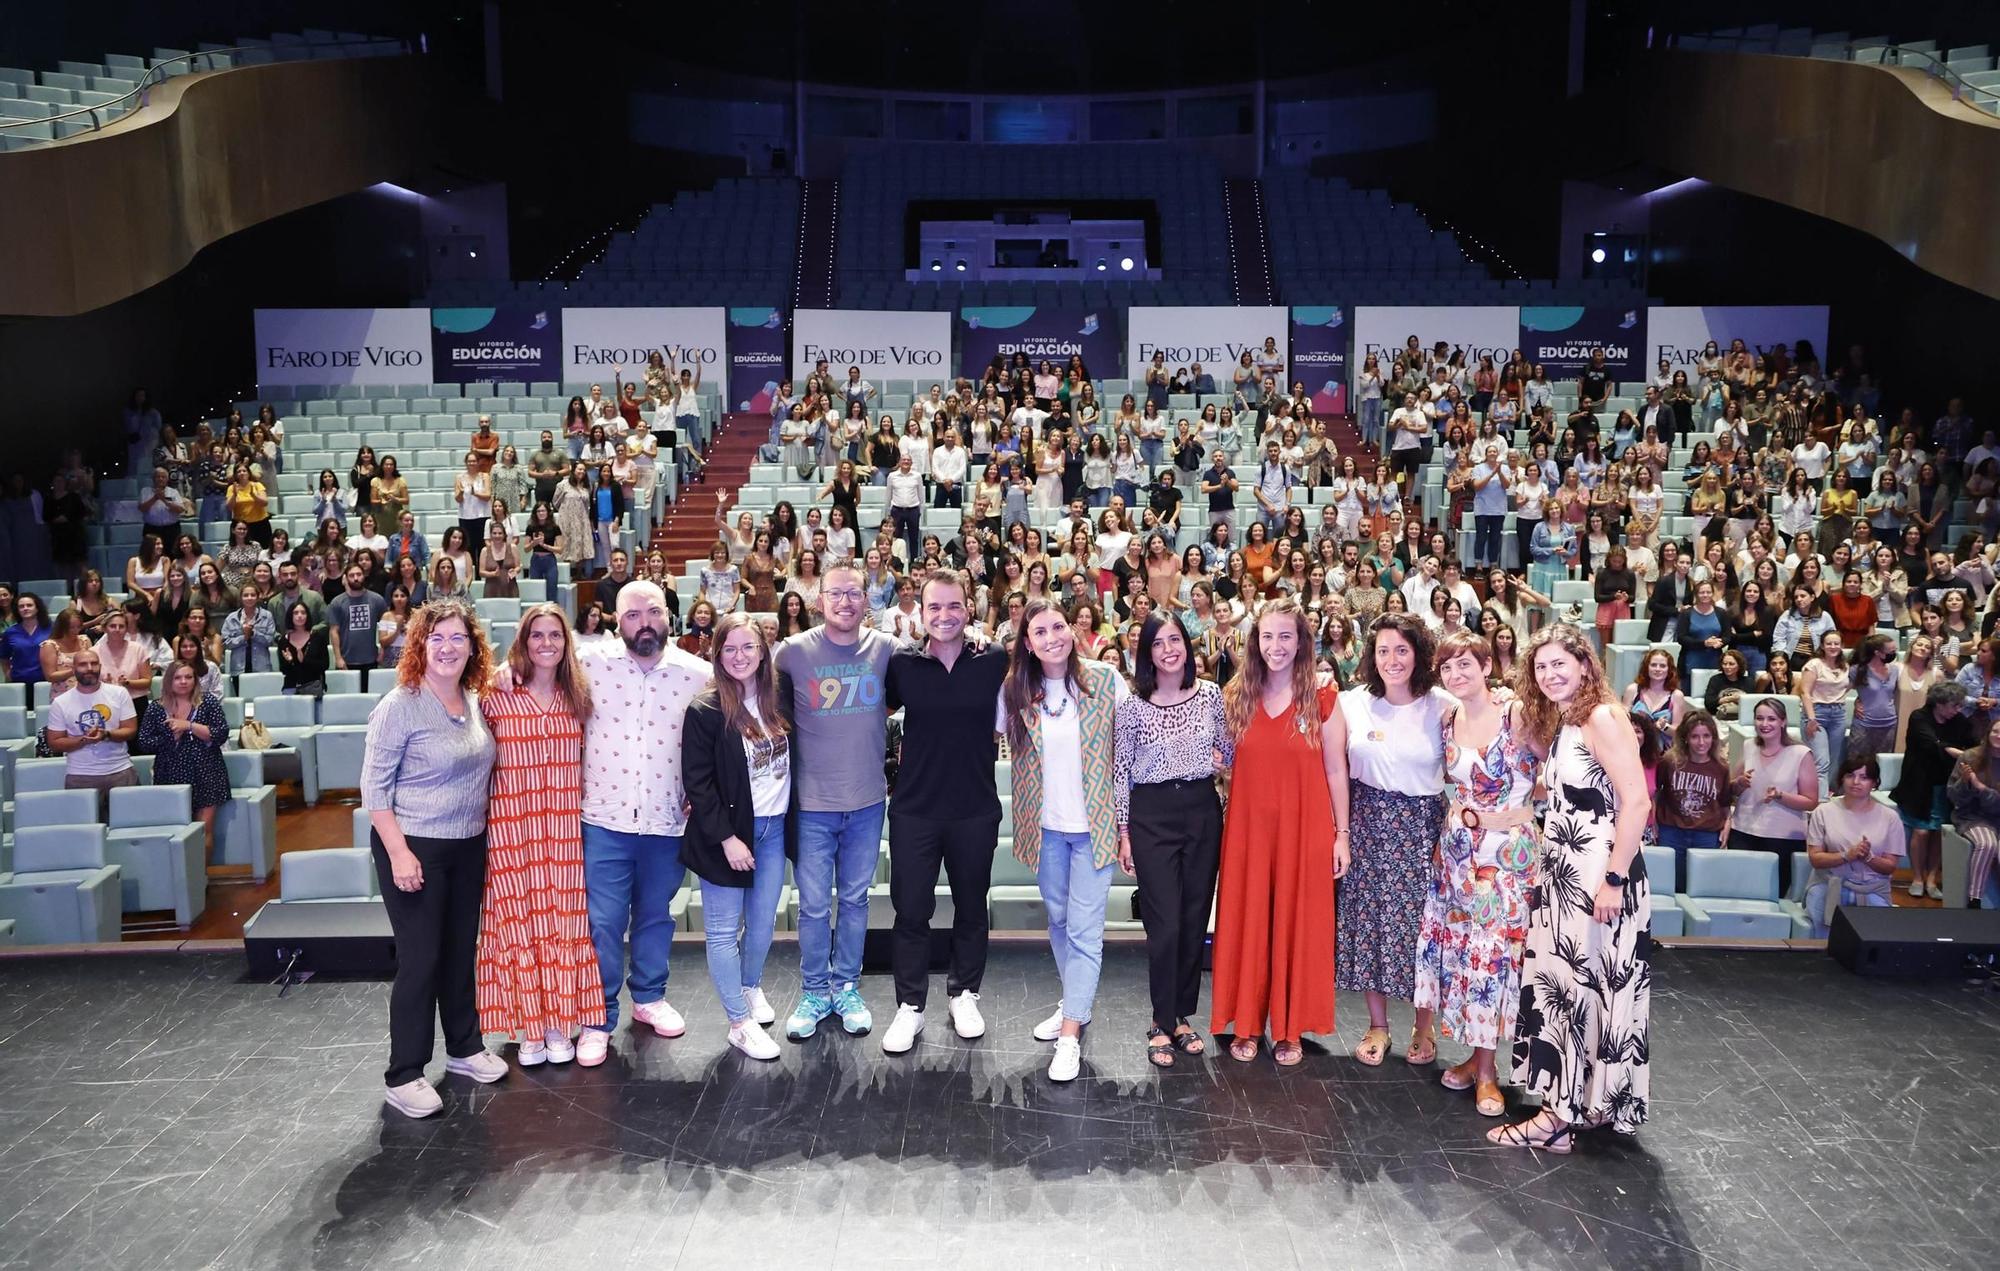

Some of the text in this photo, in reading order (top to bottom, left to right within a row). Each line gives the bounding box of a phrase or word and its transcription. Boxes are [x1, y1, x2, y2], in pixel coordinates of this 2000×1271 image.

[452, 344, 541, 360] EDUCACIÓN
[574, 345, 628, 364] FARO
[803, 345, 942, 365] FARO DE VIGO
[998, 340, 1082, 355] EDUCACIÓN
[1196, 347, 1222, 363] DE
[1657, 345, 1704, 365] FAR
[267, 346, 422, 368] FARO DE VIGO
[734, 353, 782, 363] EDUCACIÓN
[1295, 353, 1343, 362] EDUCACIÓN
[814, 662, 873, 678] VINTAGE
[808, 675, 880, 710] 1970
[1671, 770, 1718, 800] ARIZONA
